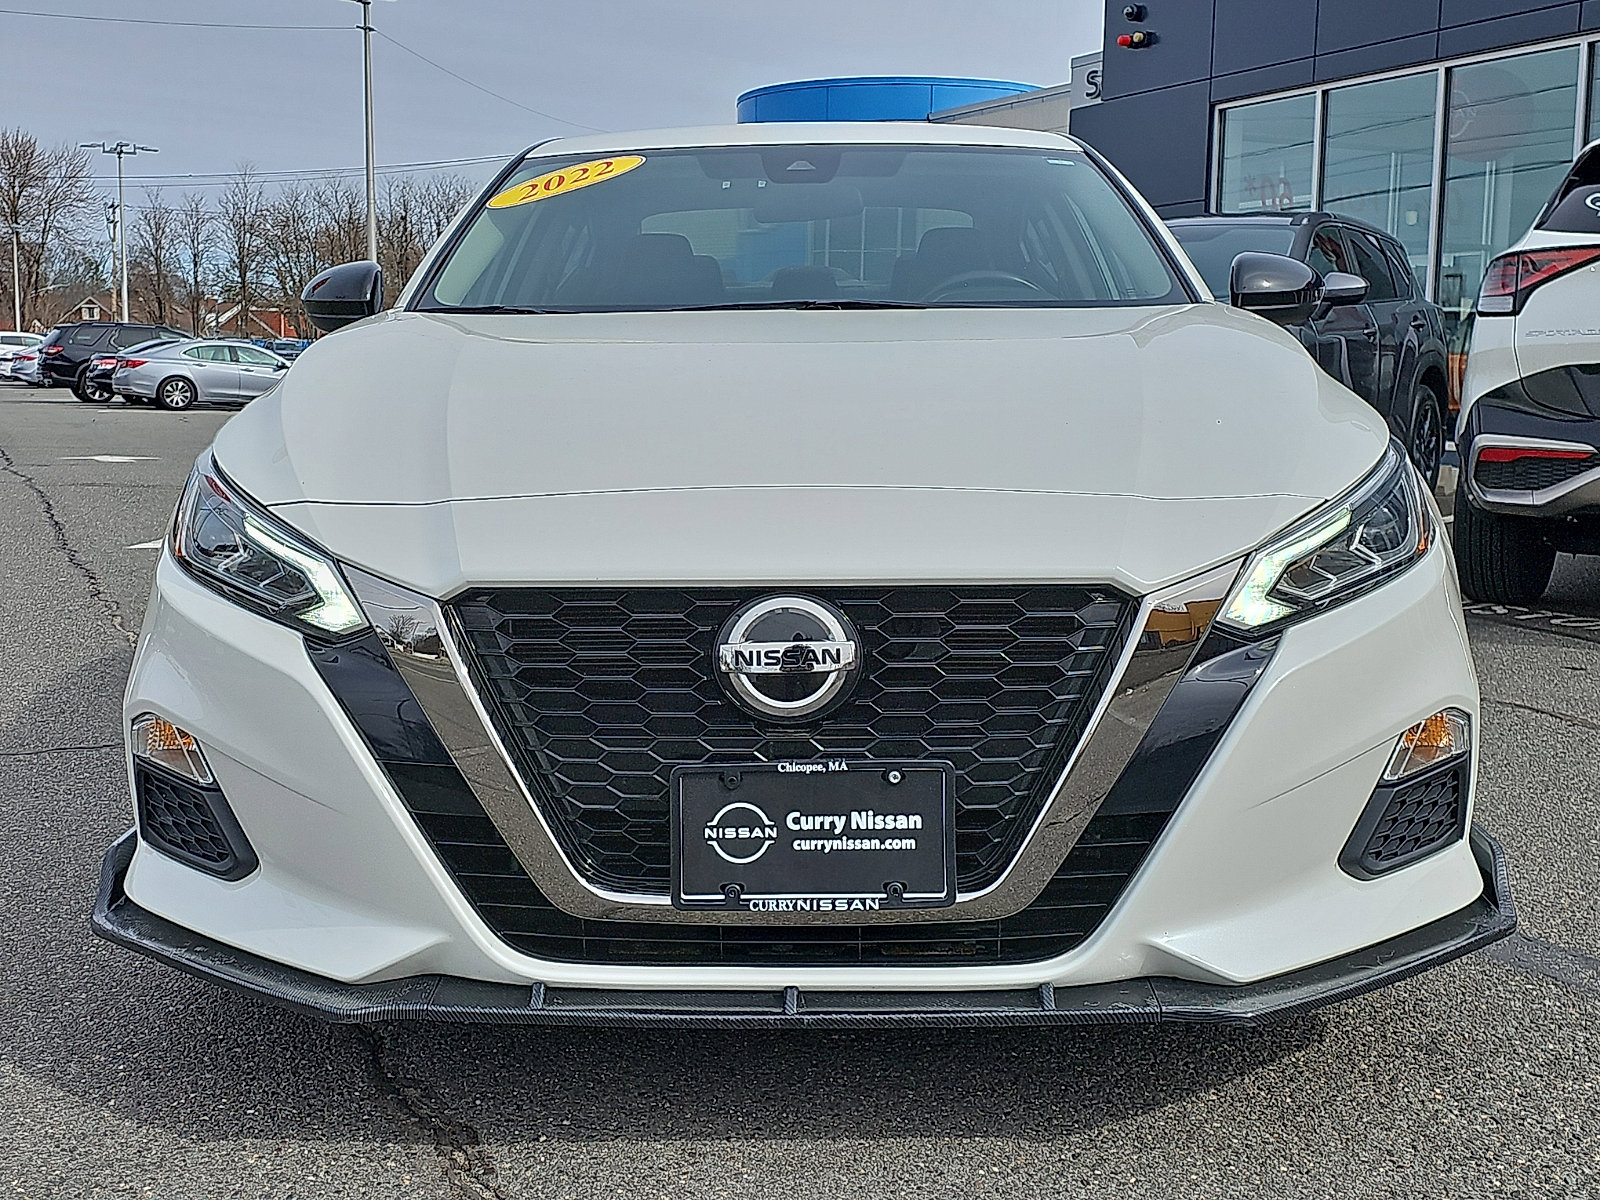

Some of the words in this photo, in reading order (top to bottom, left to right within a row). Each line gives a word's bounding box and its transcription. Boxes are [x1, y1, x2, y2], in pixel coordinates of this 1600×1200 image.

[518, 161, 614, 202] 2022
[734, 648, 841, 667] NISSAN
[777, 762, 826, 774] Chicopee,
[828, 761, 849, 772] MA
[786, 812, 847, 833] Curry
[850, 810, 923, 830] Nissan
[704, 826, 778, 840] NISSAN
[792, 836, 917, 853] currynissan.com
